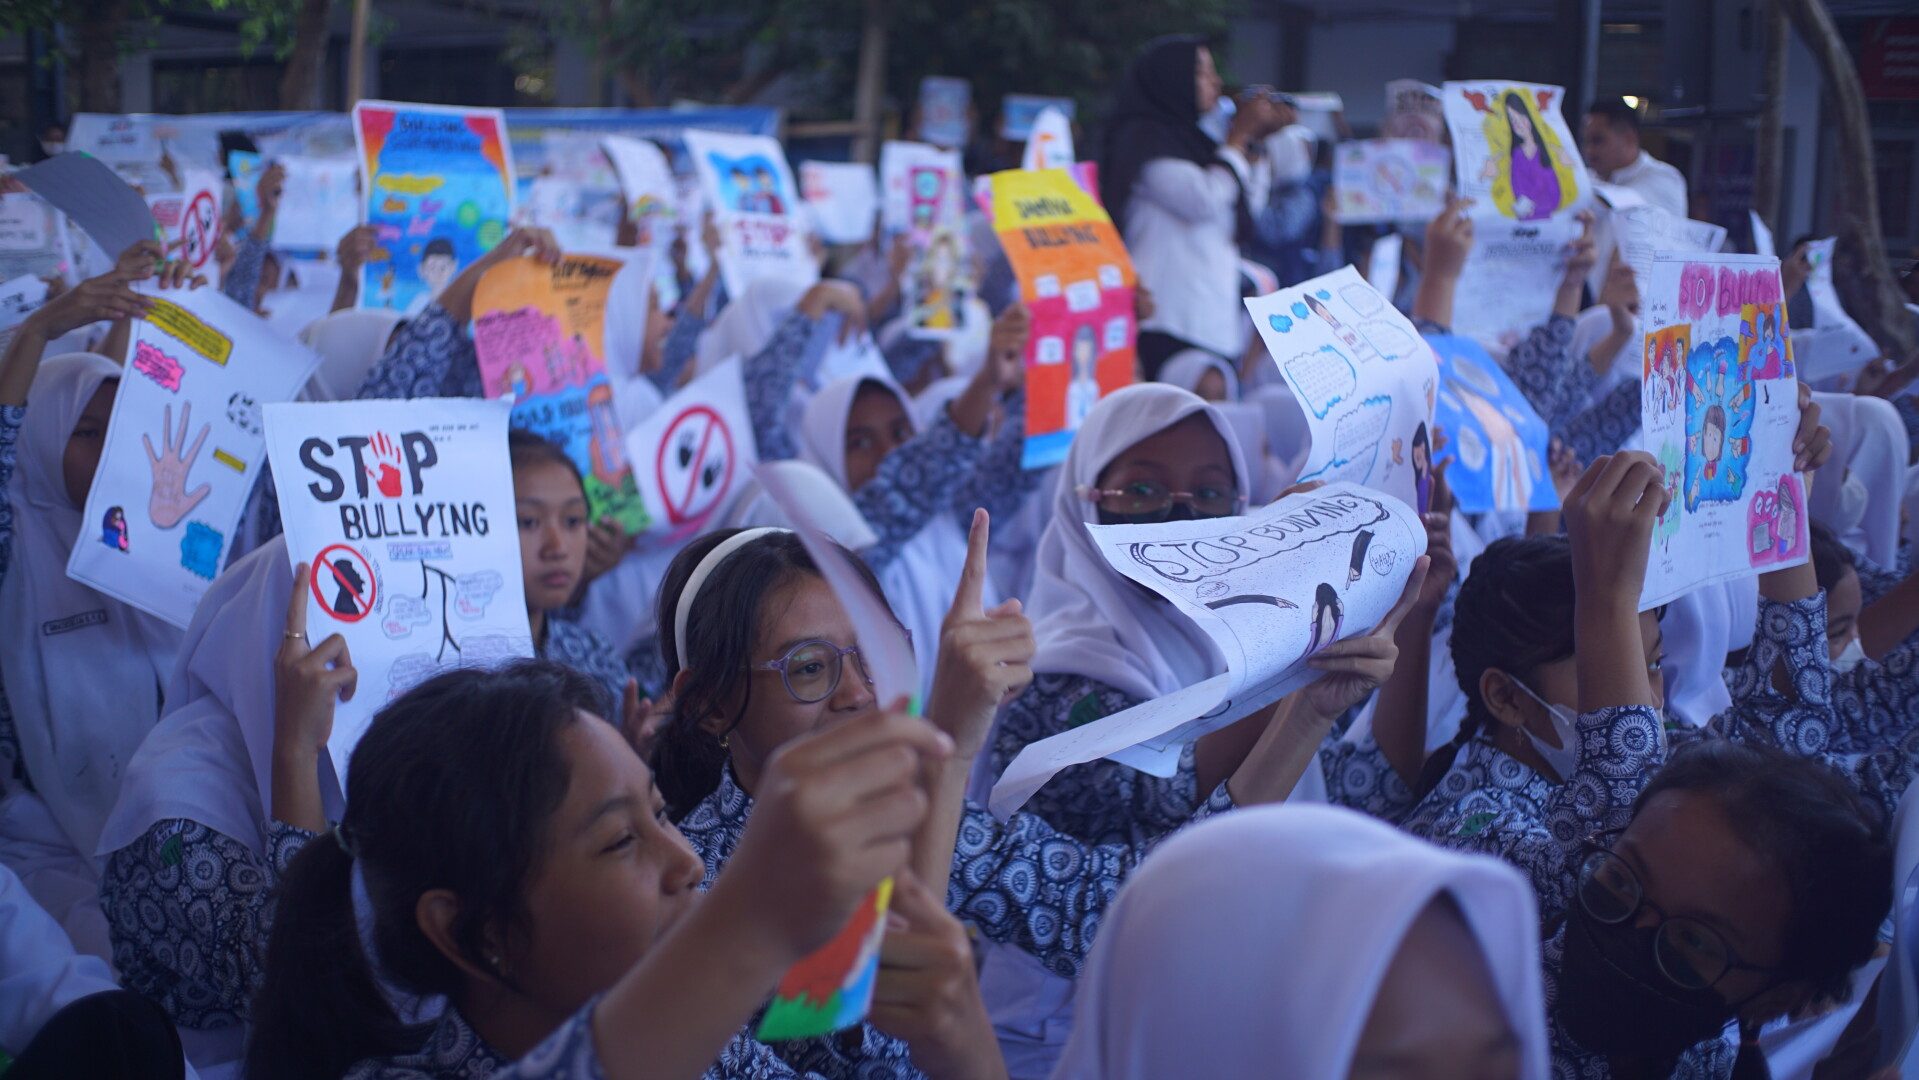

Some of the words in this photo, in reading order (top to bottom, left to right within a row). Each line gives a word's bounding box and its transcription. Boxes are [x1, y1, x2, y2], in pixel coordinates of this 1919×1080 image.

[300, 431, 438, 502] STOP
[340, 501, 490, 540] BULLYING
[1141, 535, 1258, 576] STOP
